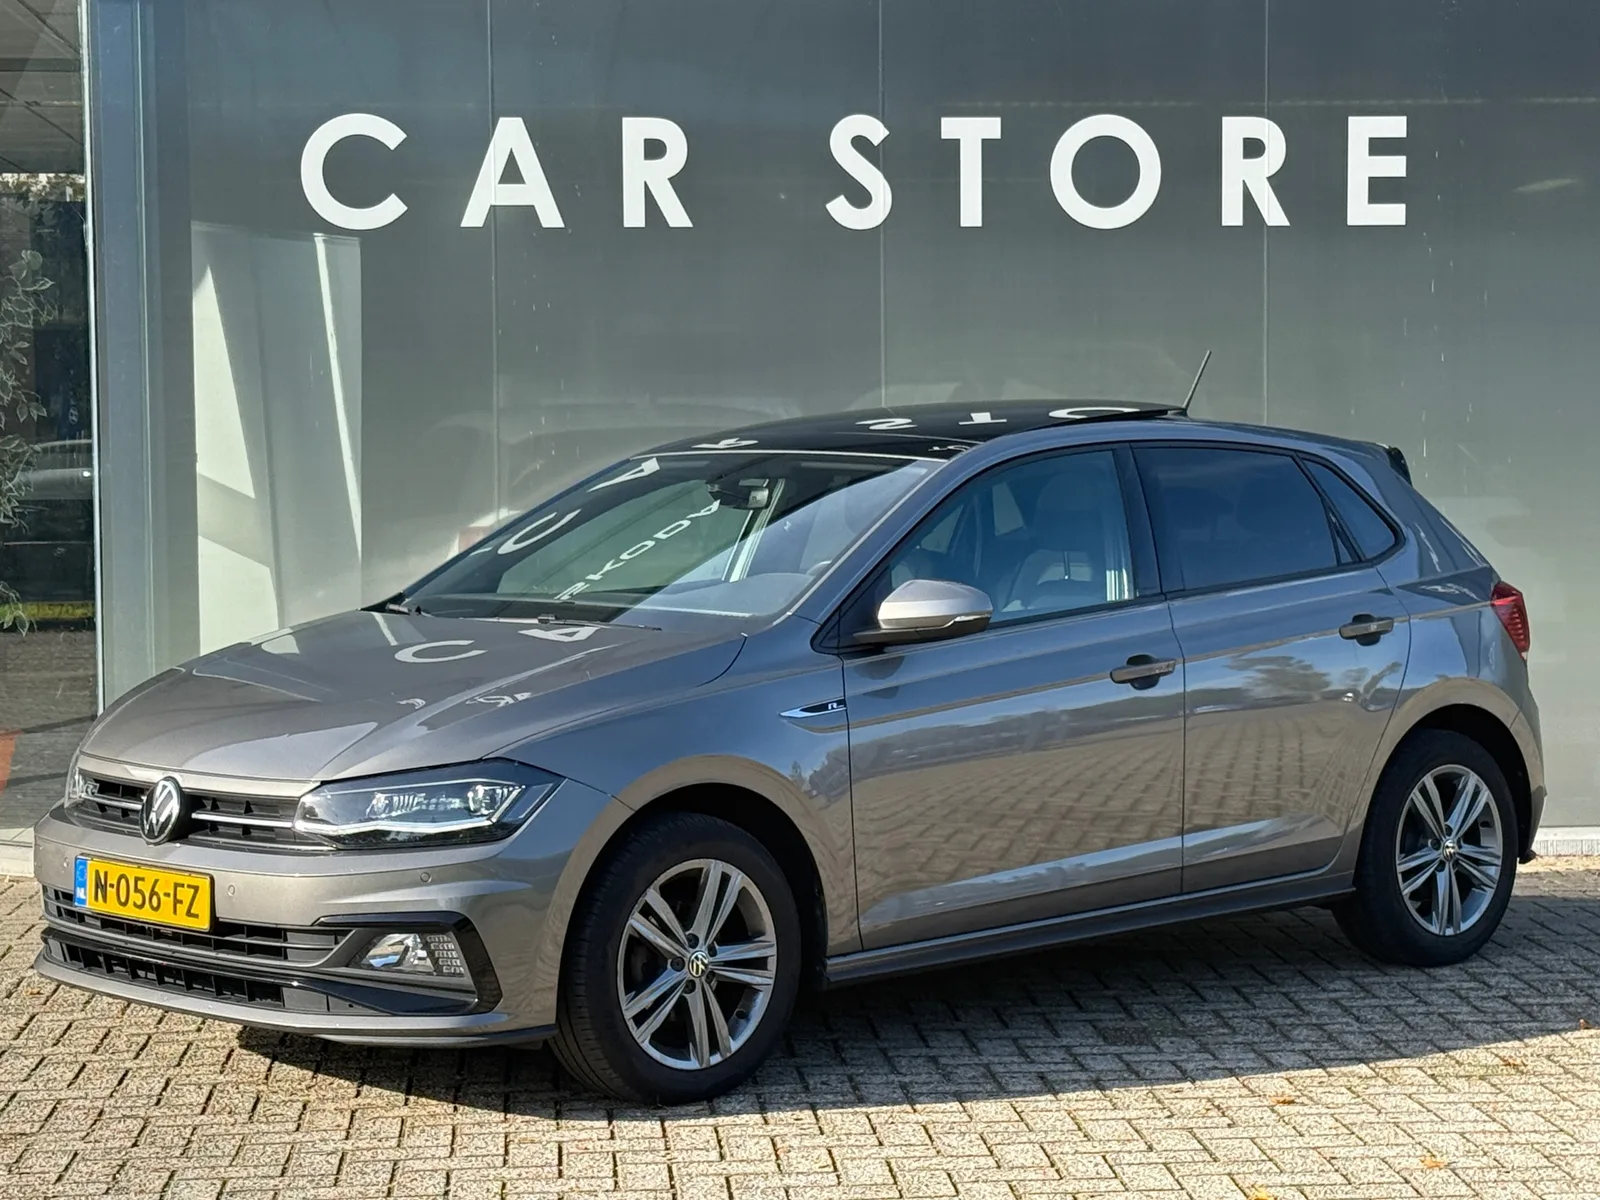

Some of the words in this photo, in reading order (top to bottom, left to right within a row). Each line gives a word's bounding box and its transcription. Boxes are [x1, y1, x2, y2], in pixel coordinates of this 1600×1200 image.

[300, 113, 693, 230] CAR
[825, 113, 1408, 230] STORE
[76, 886, 87, 899] NL
[94, 869, 200, 919] N-056-FZ
